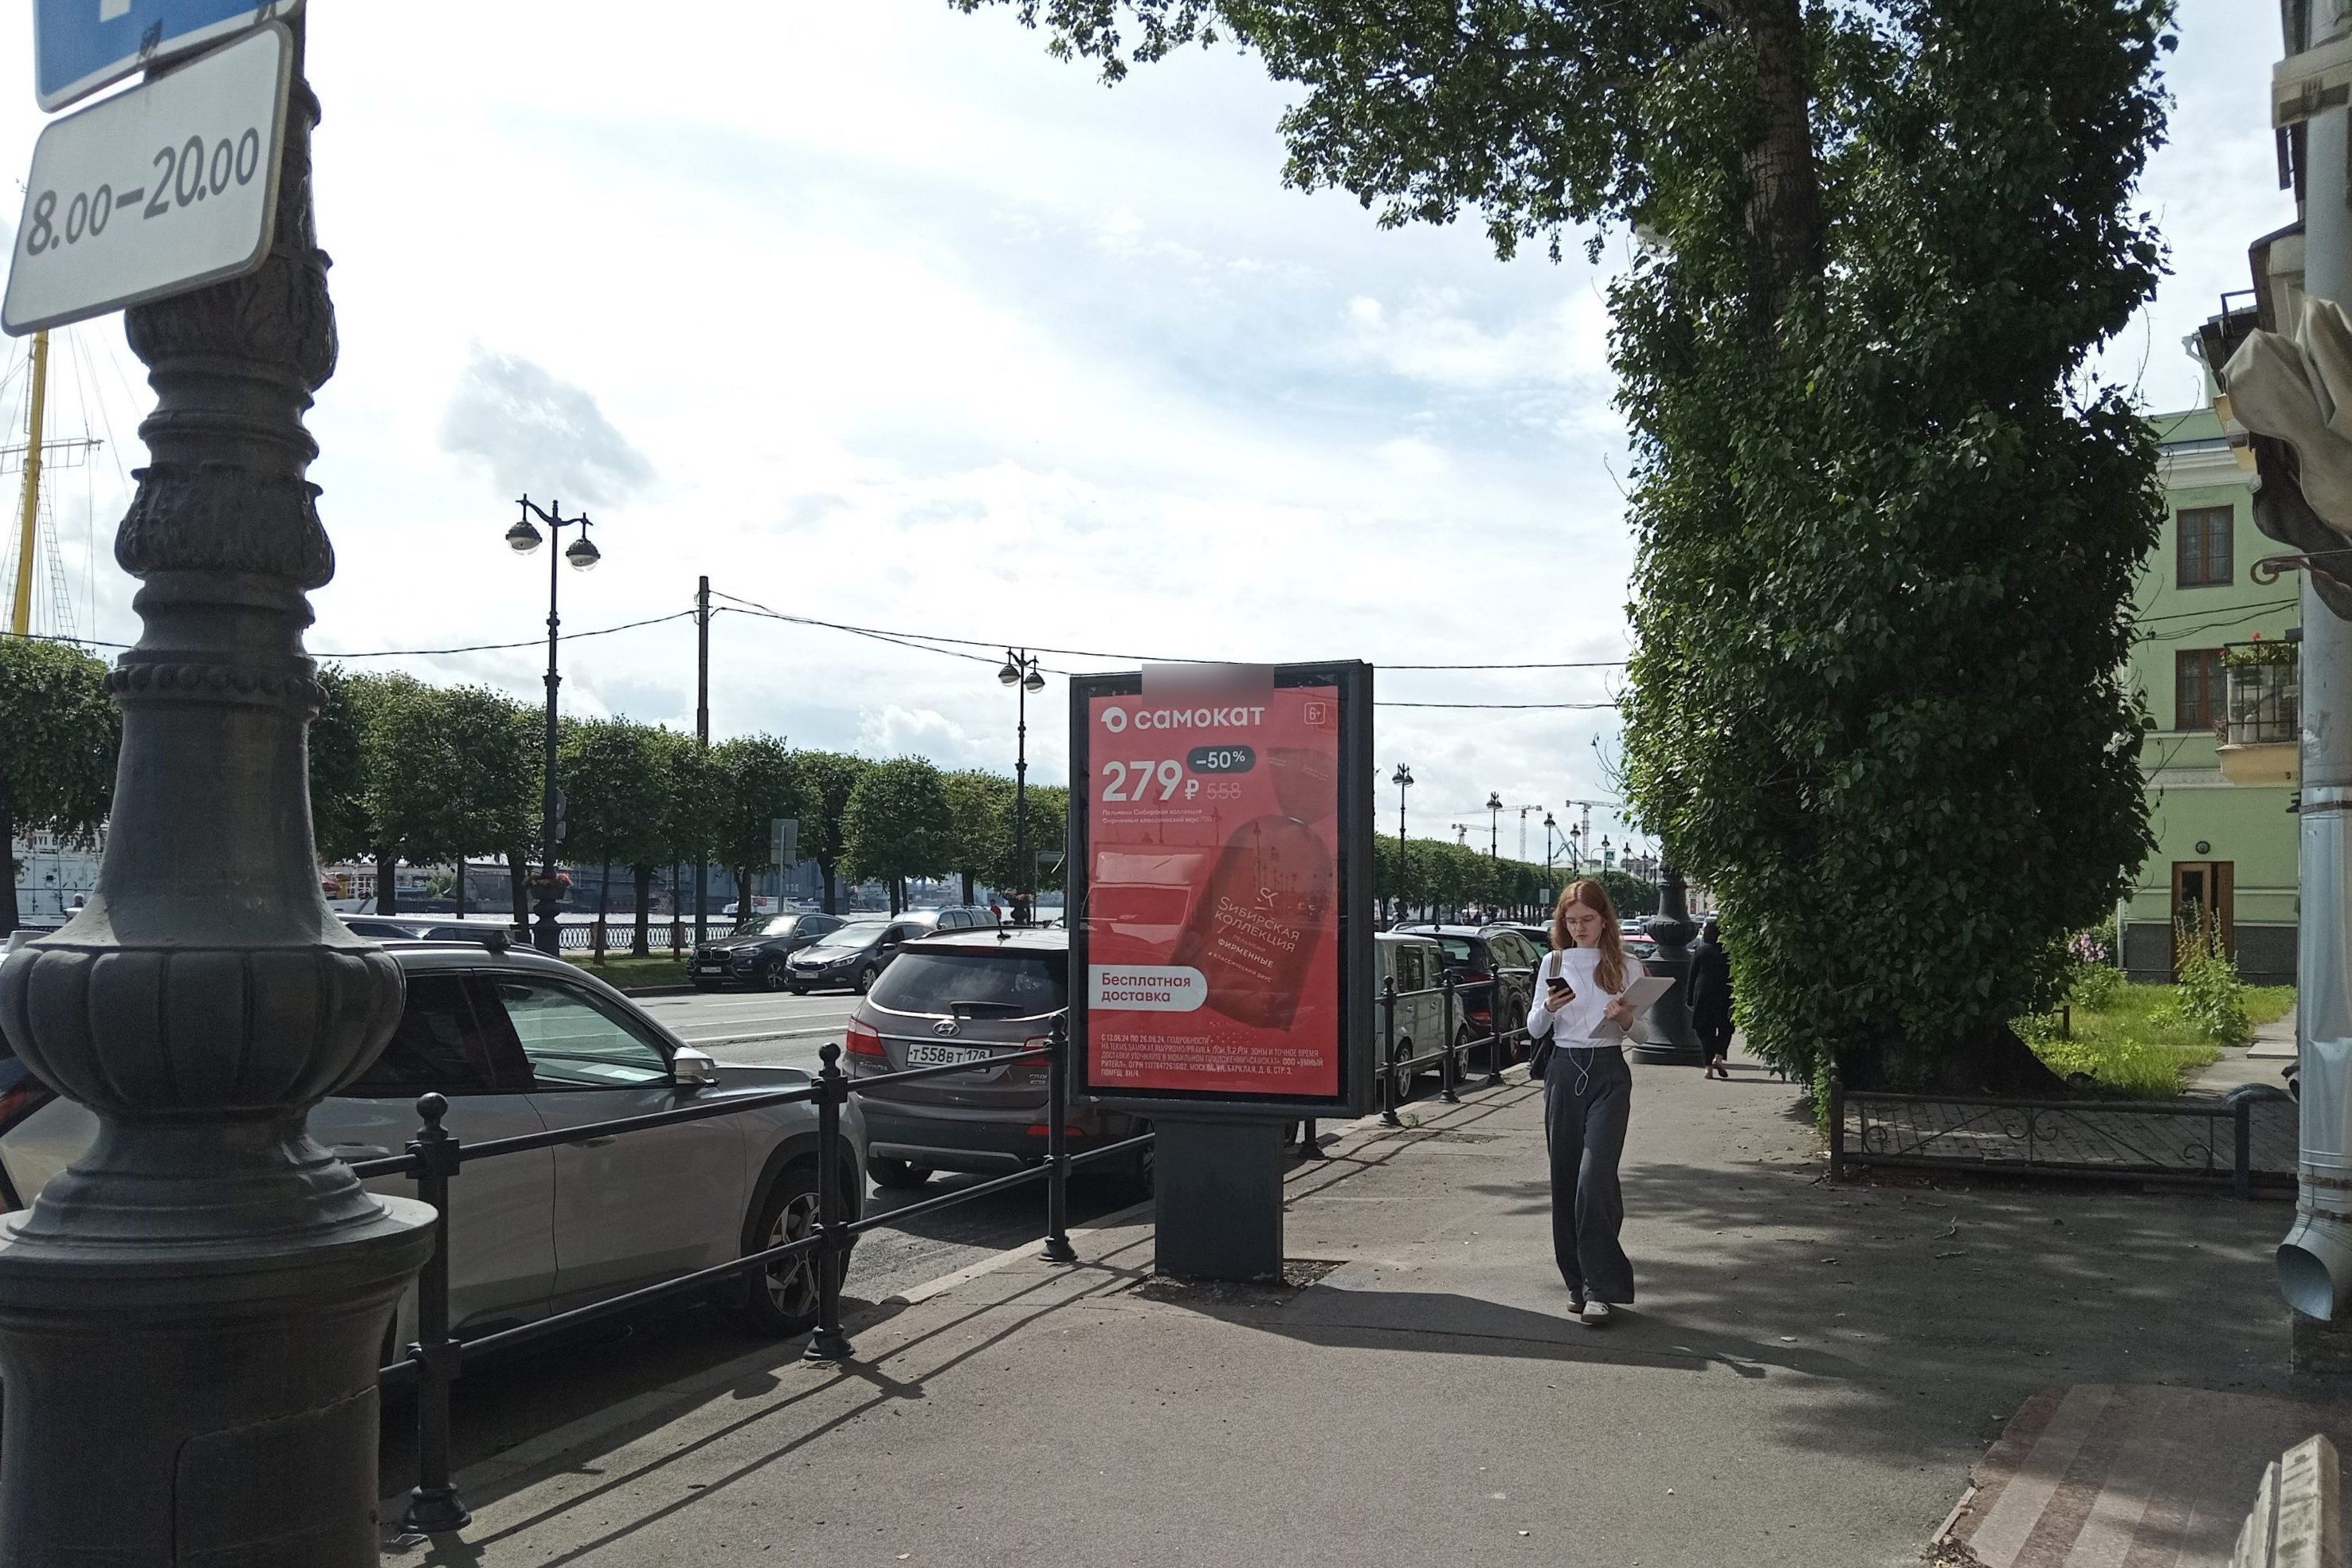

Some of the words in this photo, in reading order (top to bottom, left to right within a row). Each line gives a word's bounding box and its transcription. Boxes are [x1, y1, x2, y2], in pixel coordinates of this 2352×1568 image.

[25, 127, 260, 256] 8.00-20.00
[1135, 707, 1265, 730] самокат
[1309, 707, 1322, 720] 6+
[1196, 751, 1245, 769] -50%
[1205, 782, 1242, 800] 558
[1214, 910, 1296, 953] КОЛЛЕКЦИЯ
[1217, 939, 1273, 968] ФИРМЕННЫЕ
[1102, 972, 1190, 987] Бесплатная
[1101, 991, 1170, 1002] доставка
[1101, 1051, 1130, 1060] ДОСТАВКИ
